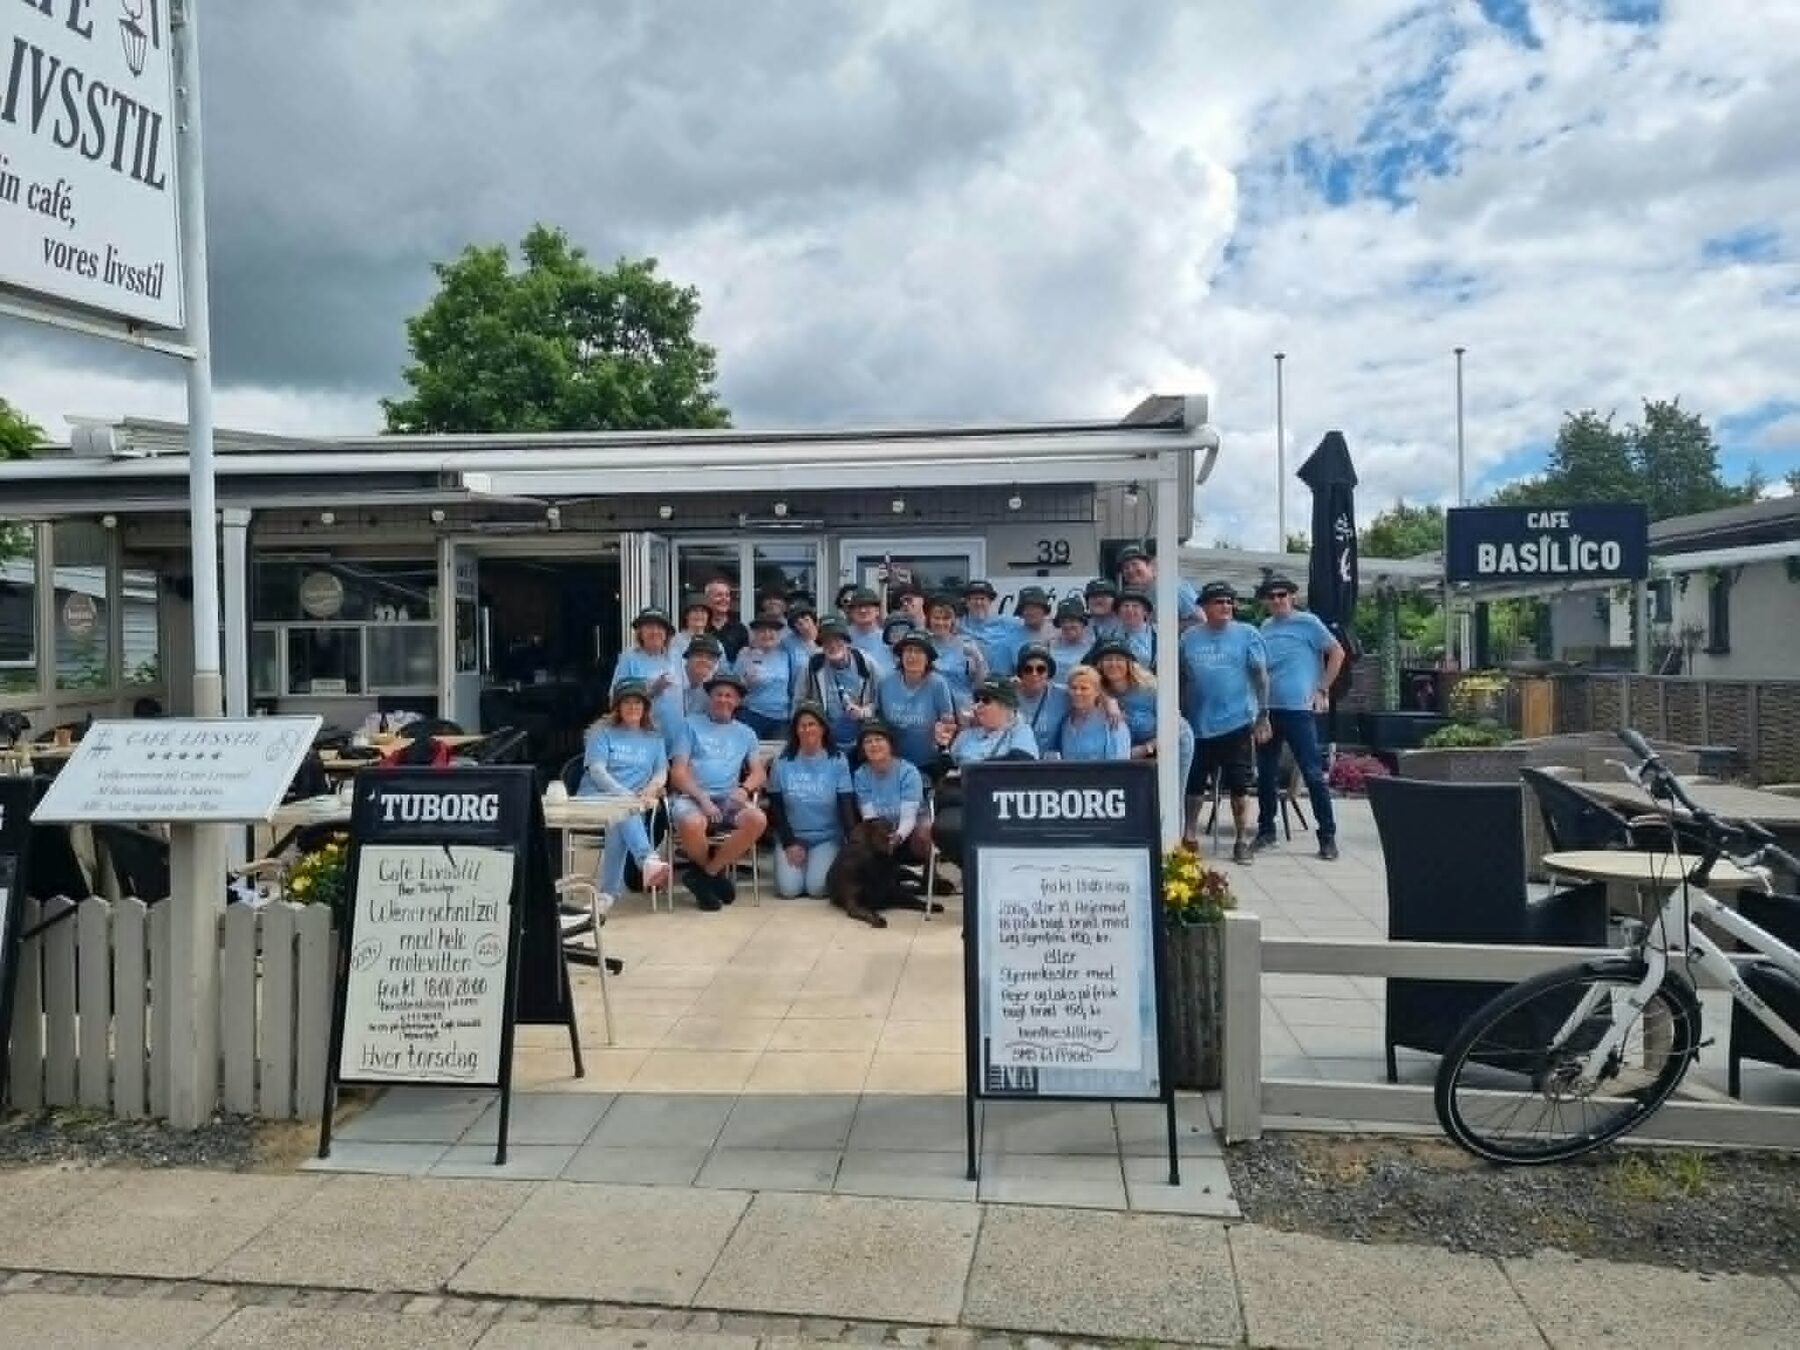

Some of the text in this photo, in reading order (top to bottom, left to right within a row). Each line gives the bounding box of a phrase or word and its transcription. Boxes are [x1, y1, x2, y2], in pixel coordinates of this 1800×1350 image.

[0, 36, 165, 191] IVSSTIL
[28, 178, 76, 229] café,
[43, 236, 164, 300] vores livsstil
[1527, 512, 1570, 528] CAFE
[1037, 540, 1070, 563] 39
[380, 793, 498, 822] TUBORG
[992, 789, 1126, 819] TUBORG
[401, 927, 432, 949] med
[362, 1040, 478, 1068] Hver torsdag
